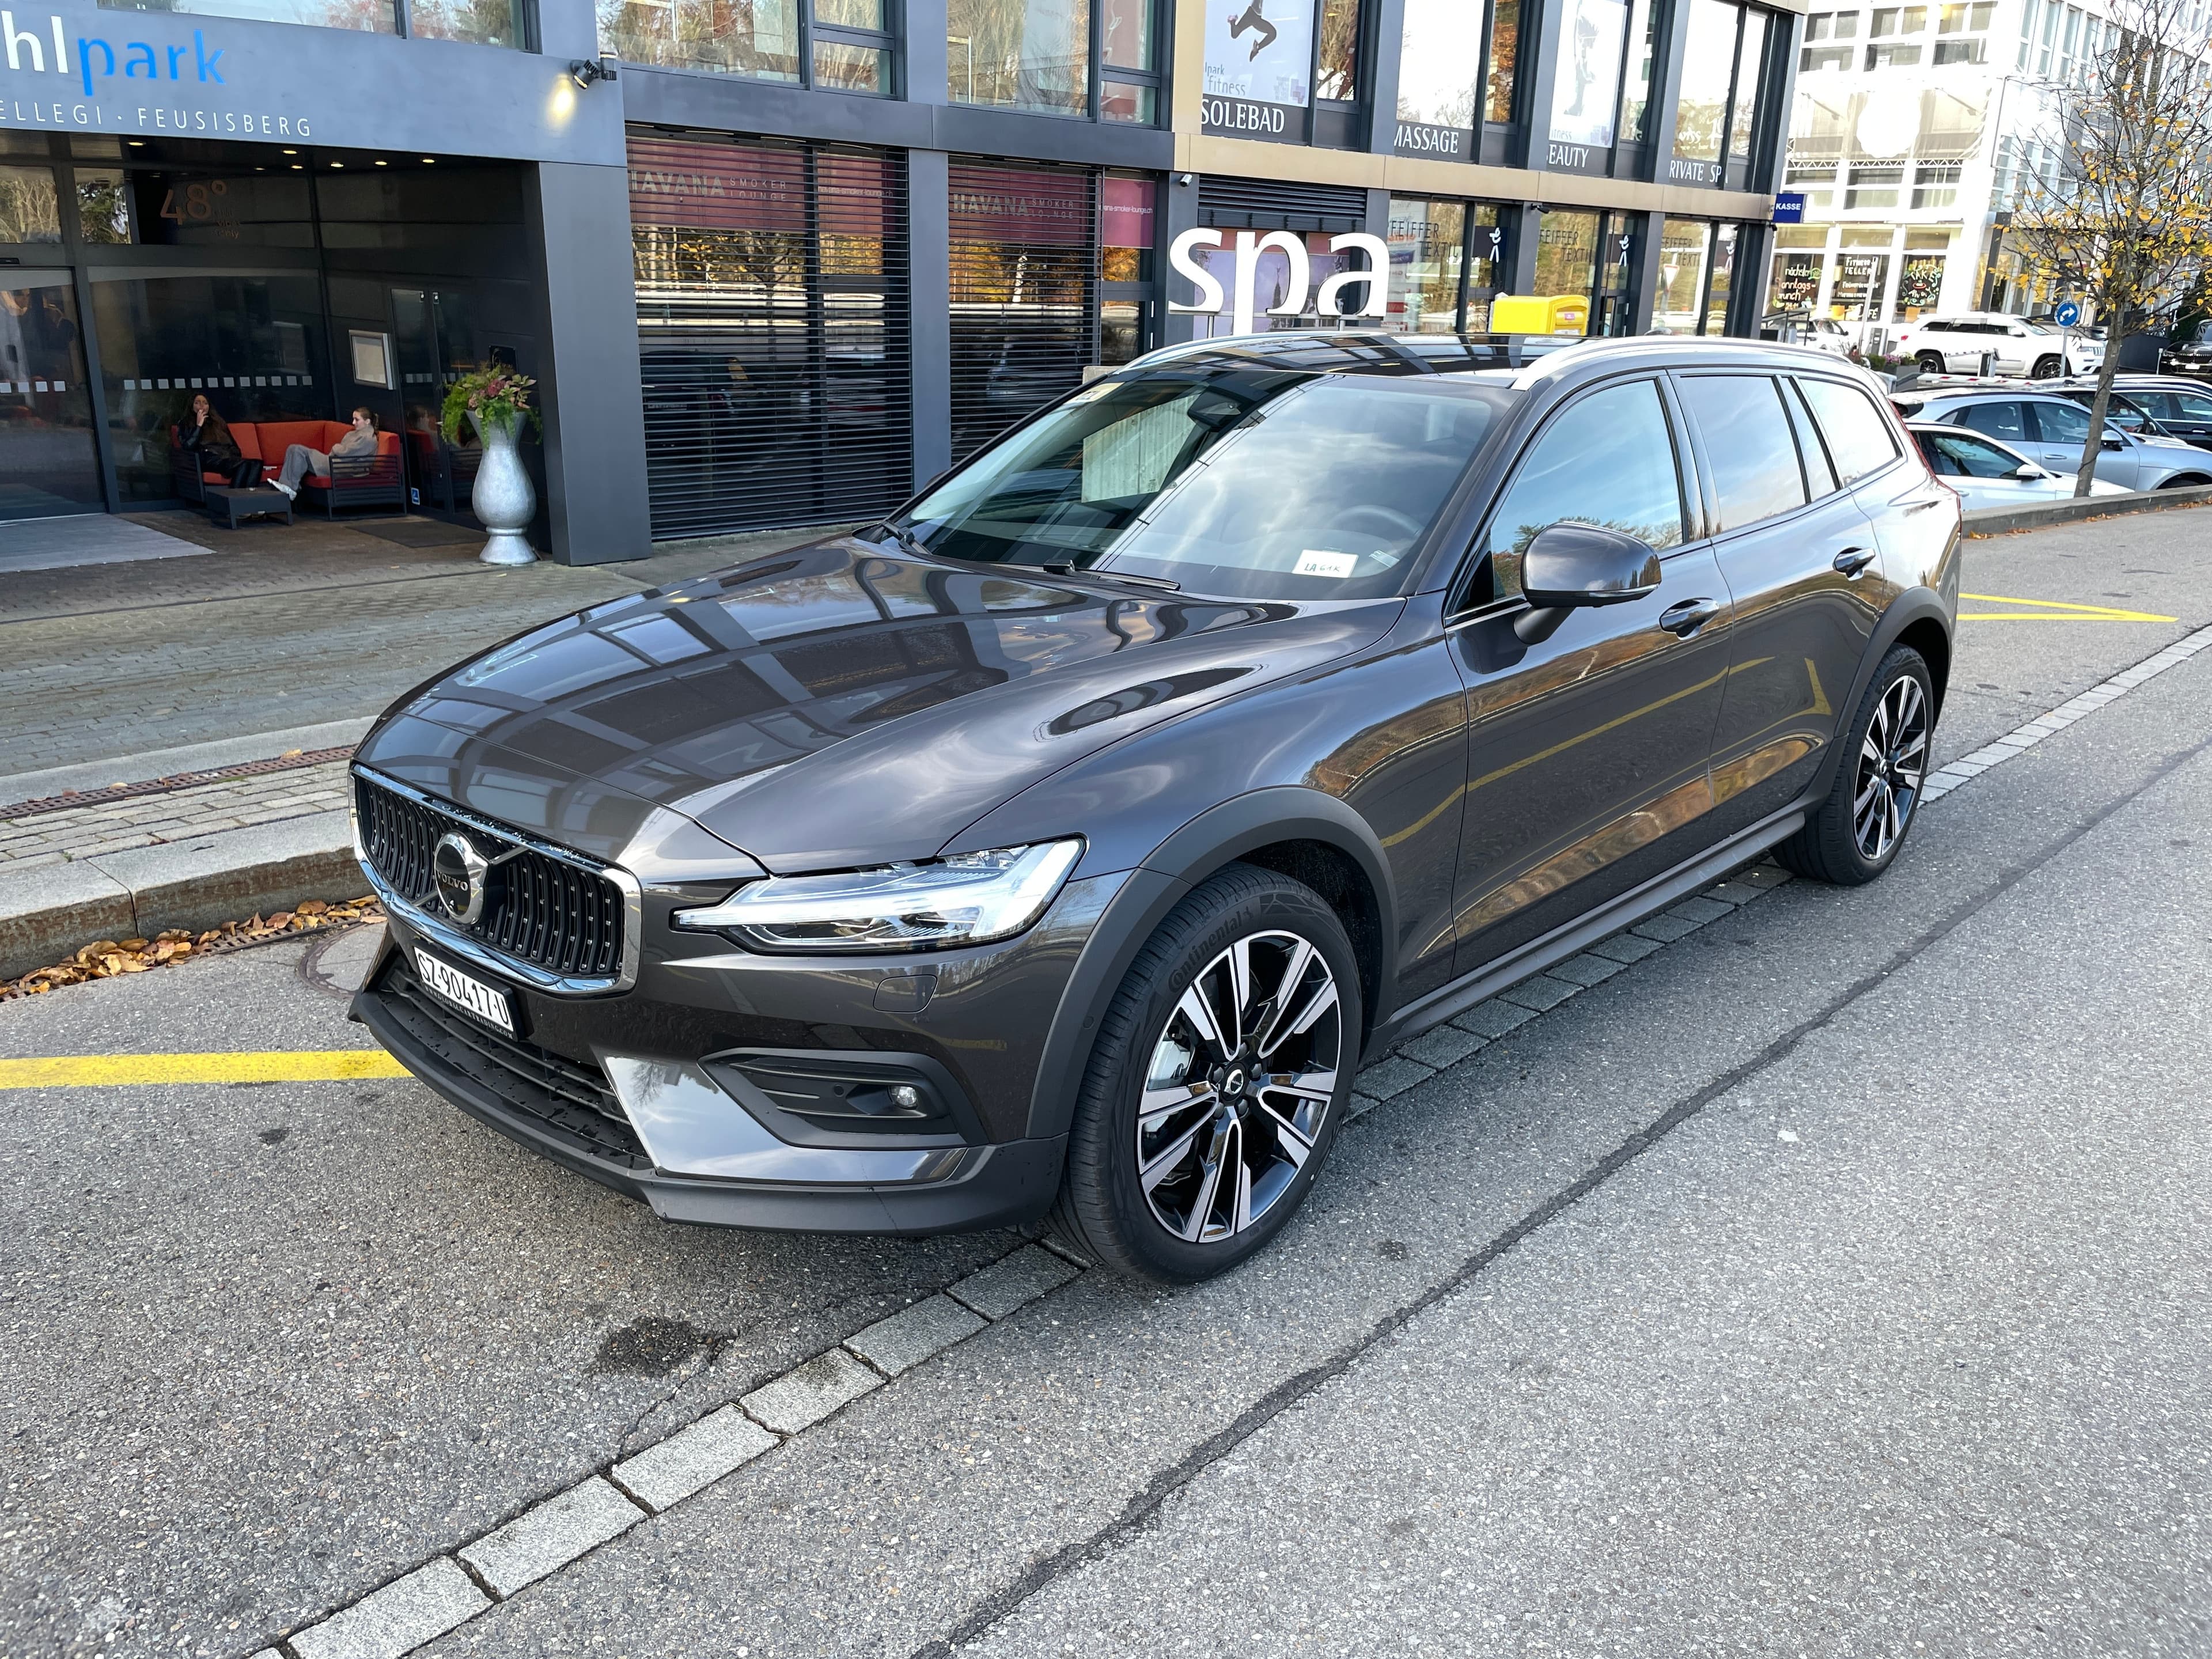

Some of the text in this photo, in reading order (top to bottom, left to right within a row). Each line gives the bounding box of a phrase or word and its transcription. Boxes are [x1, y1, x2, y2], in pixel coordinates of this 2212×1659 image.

[1209, 75, 1246, 96] fitness
[138, 107, 310, 137] FEUSISBERG
[1201, 99, 1285, 133] SOLEBAD
[1547, 144, 1589, 168] EAUTY
[730, 177, 786, 190] SMOKER
[1709, 165, 1728, 184] SP
[953, 194, 1074, 217] HAVANA SMOKER
[1032, 210, 1074, 219] LONGE
[1775, 202, 1802, 211] KASSE
[1168, 228, 1391, 335] spa
[1304, 563, 1317, 572] LA
[436, 869, 468, 891] VOLVO
[1168, 911, 1244, 993] Continental
